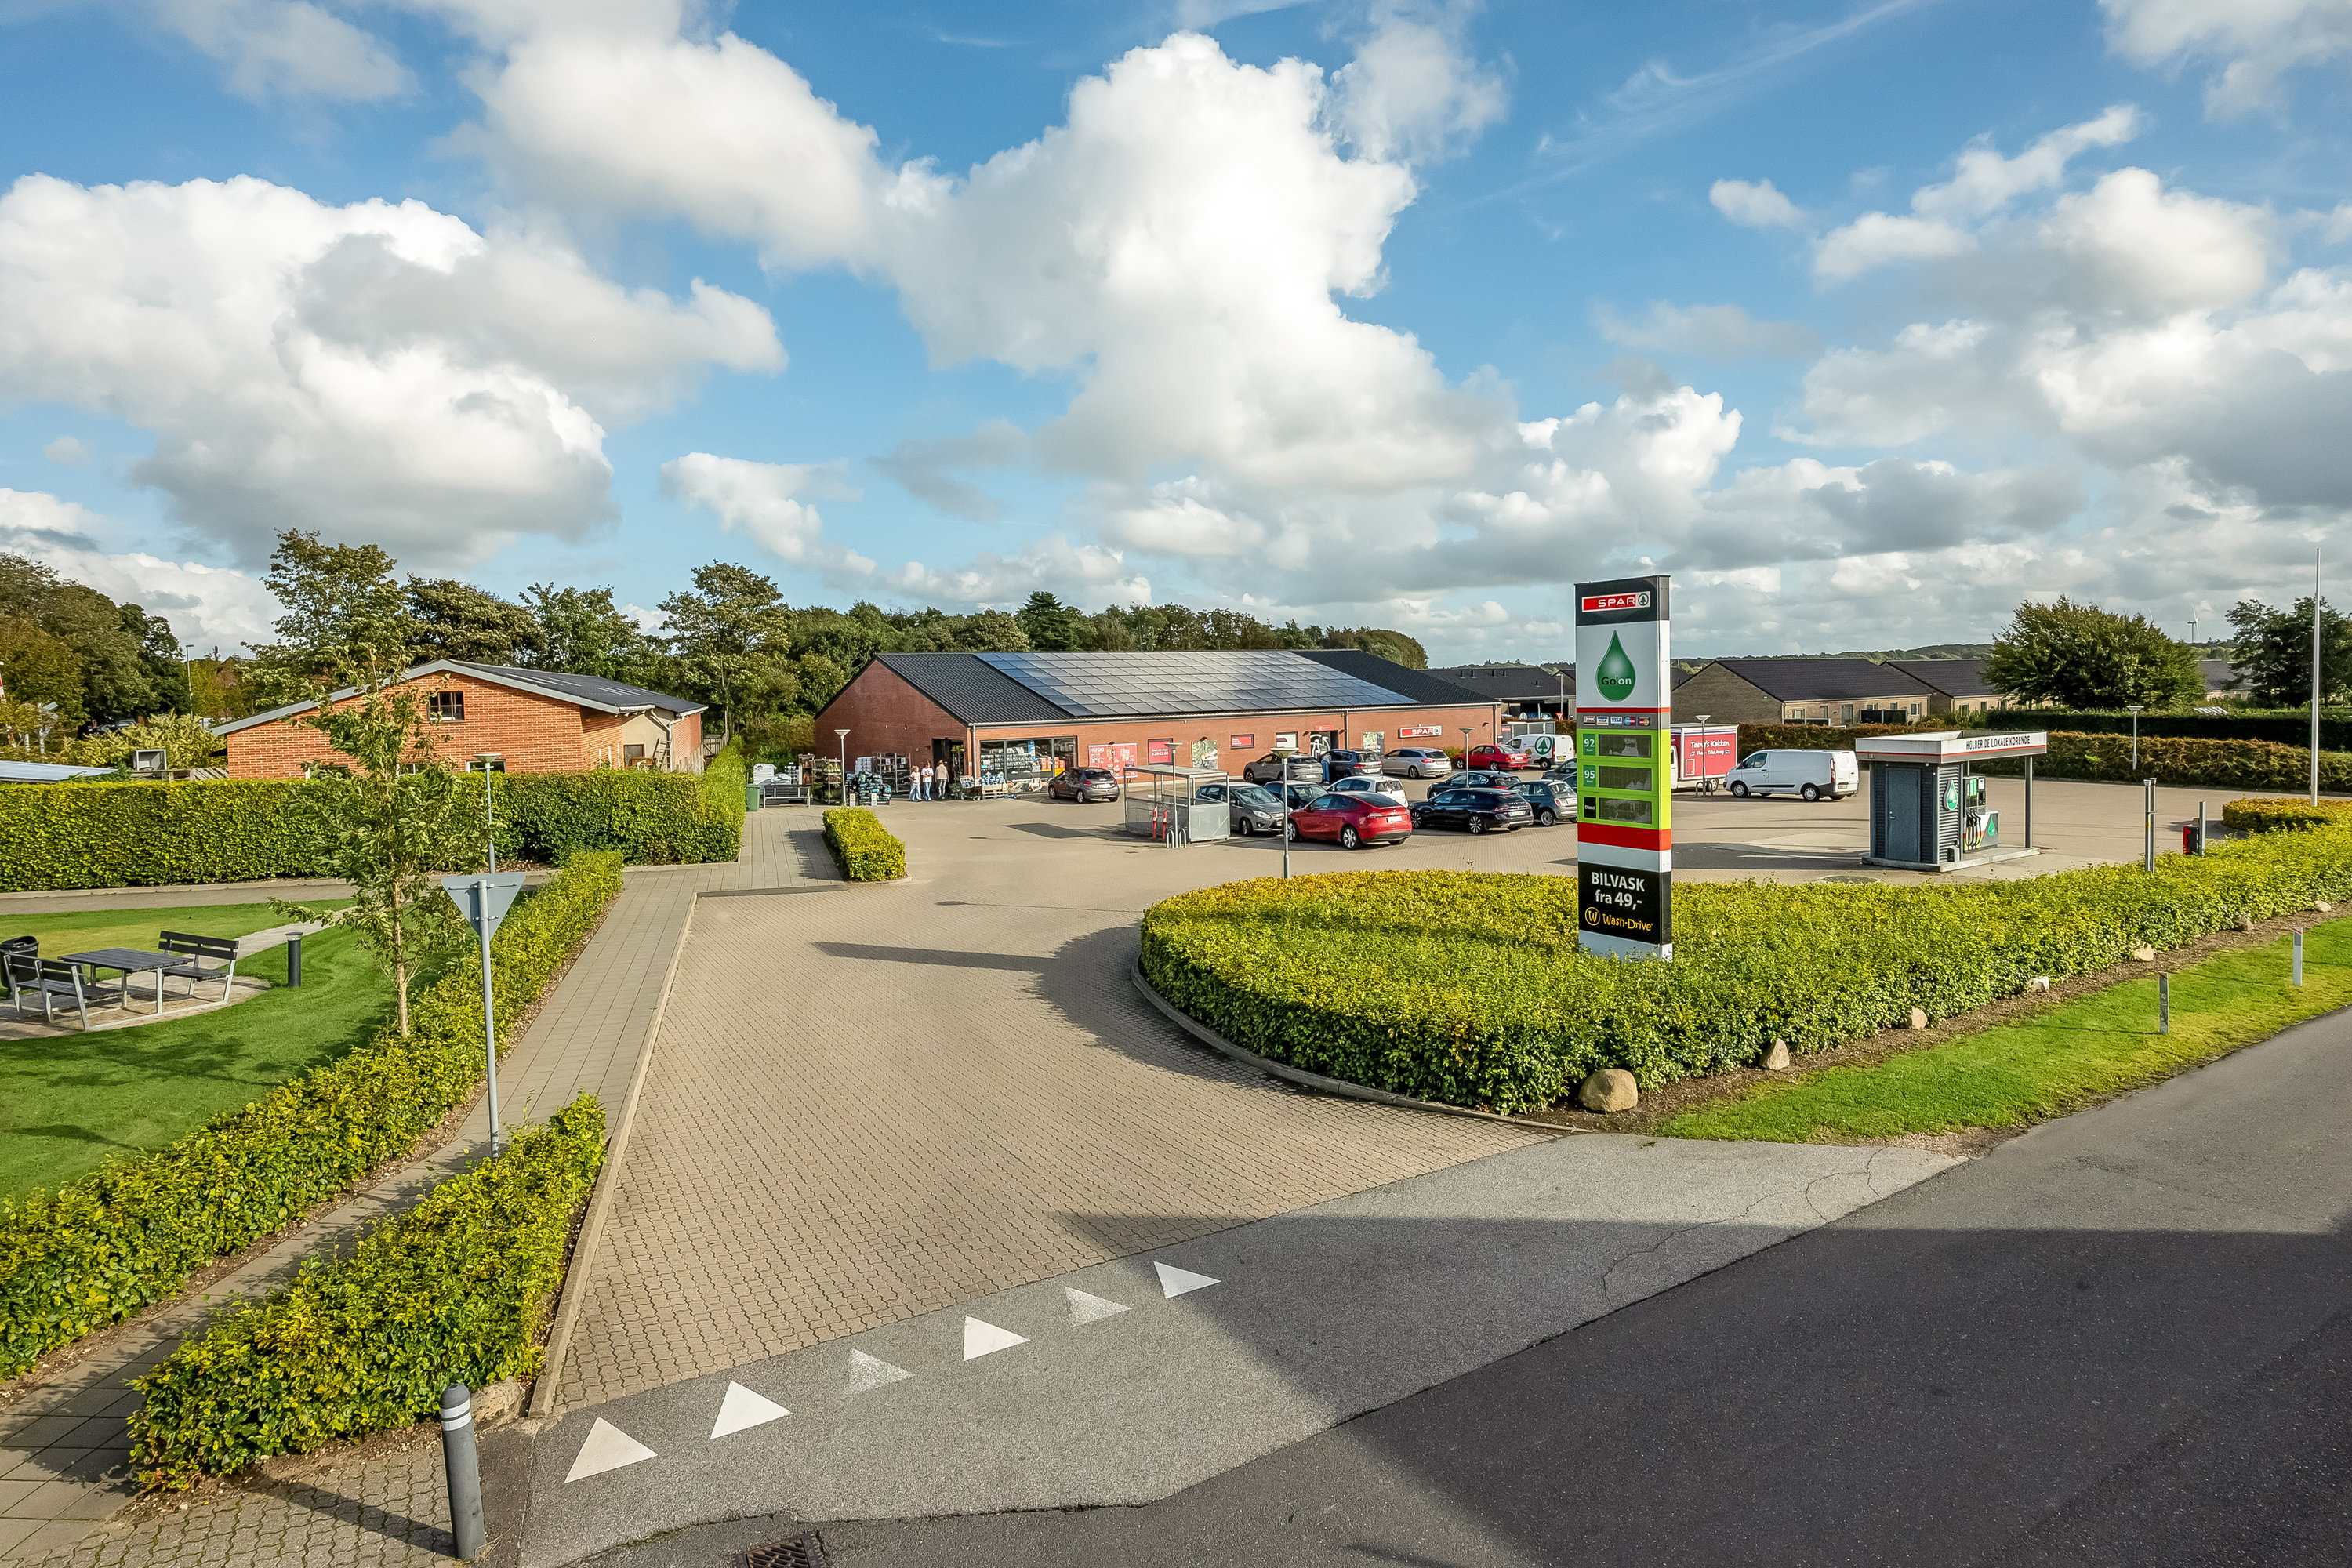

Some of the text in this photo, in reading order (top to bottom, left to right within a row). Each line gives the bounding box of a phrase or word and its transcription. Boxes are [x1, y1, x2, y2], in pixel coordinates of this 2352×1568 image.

[1598, 597, 1635, 608] SPAR
[1601, 676, 1632, 685] Go'on
[1584, 739, 1595, 747] 92
[1966, 739, 1984, 750] HOLDER
[1984, 739, 1990, 748] DE
[1991, 737, 2009, 747] LOKALE
[1584, 770, 1595, 779] 95
[1592, 871, 1645, 892] BILVASK
[1595, 889, 1642, 910] fra 49,-
[1602, 913, 1653, 931] Wash-Drive
